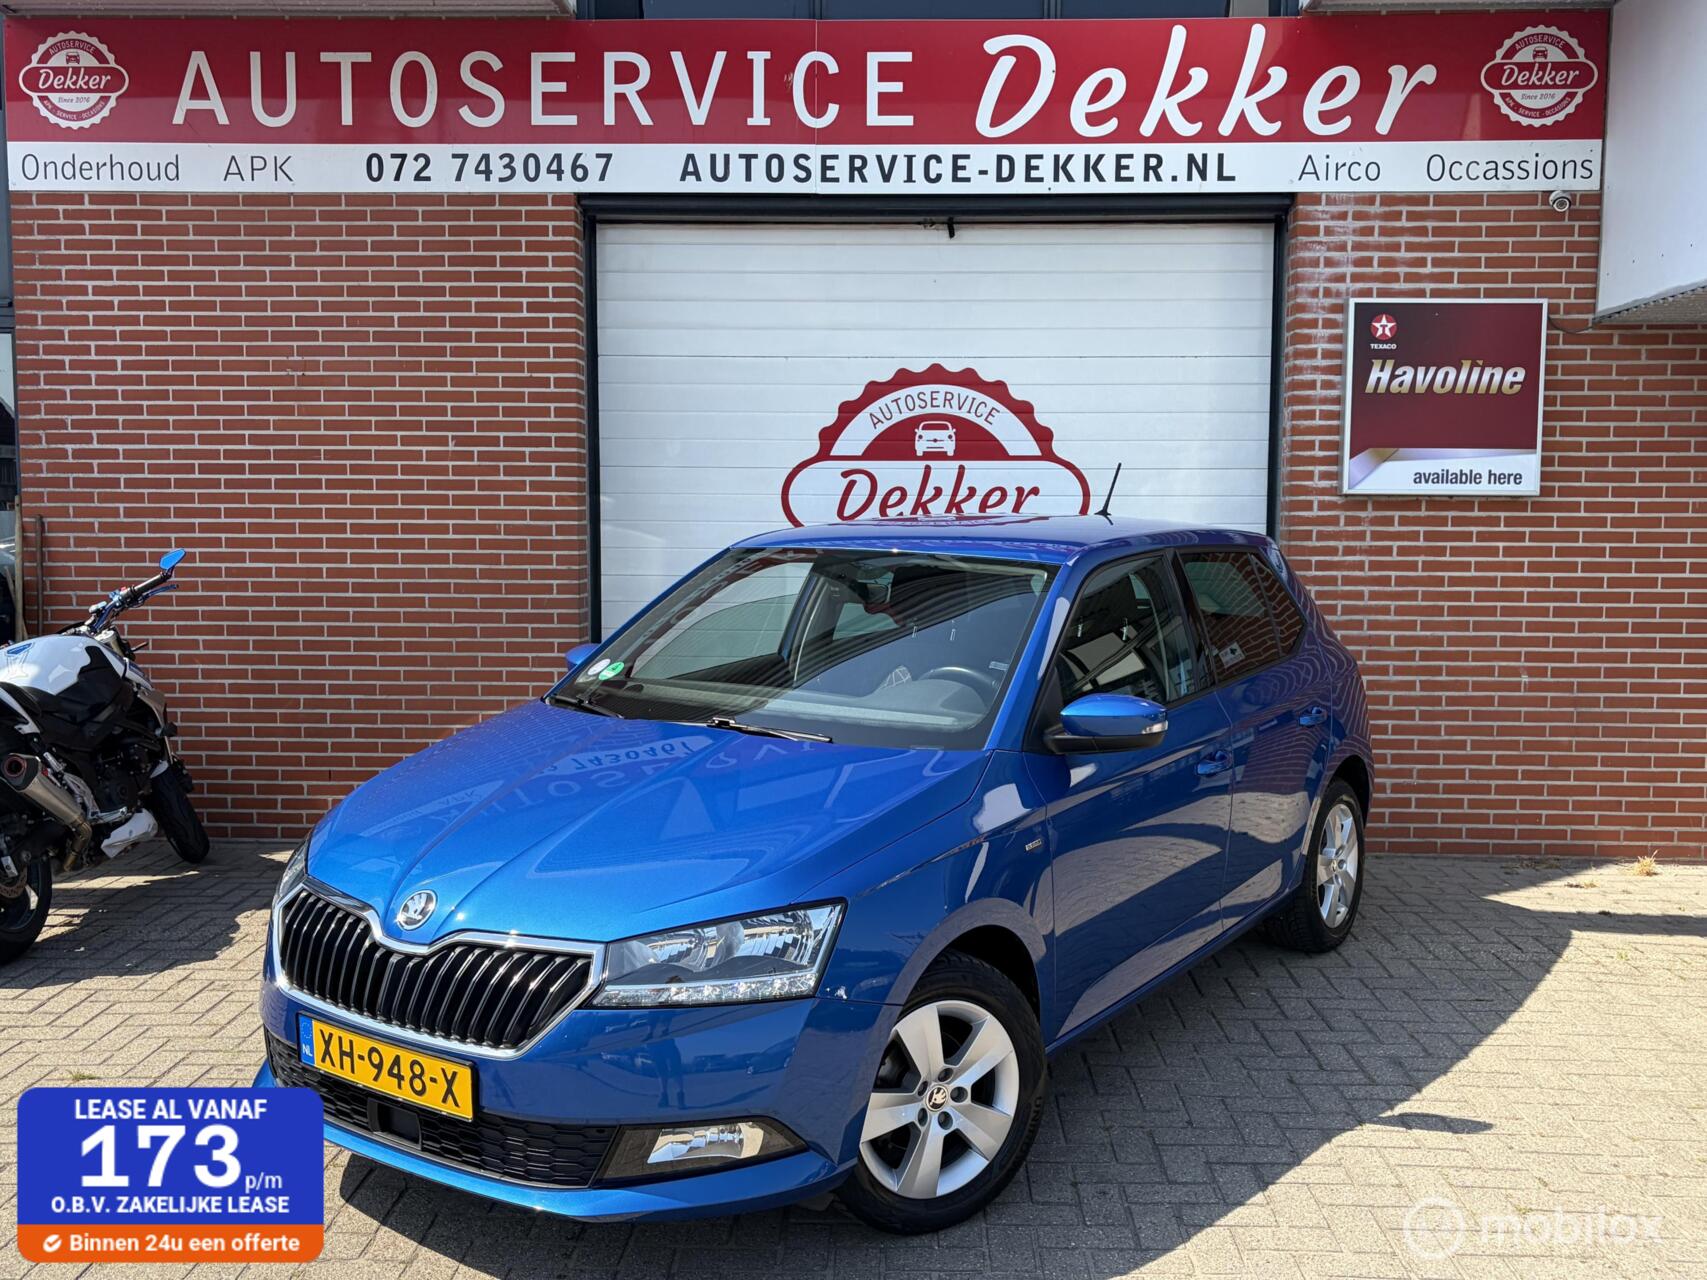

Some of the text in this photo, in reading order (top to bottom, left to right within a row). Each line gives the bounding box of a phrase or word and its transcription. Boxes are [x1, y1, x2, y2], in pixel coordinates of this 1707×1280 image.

[48, 40, 96, 56] AUTOSERVICE
[1514, 34, 1566, 51] AUTOSERVICE
[38, 67, 111, 90] Dekker
[171, 23, 1437, 139] AUTOSERVICE Dekker
[1501, 62, 1580, 86] Dekker
[1520, 93, 1538, 101] Since
[1518, 107, 1540, 118] SERVICE
[21, 152, 1594, 183] Onderhoud APK 072 7430467 AUTOSERVICE-DEKKER.NL Airco Occassions
[1364, 359, 1526, 395] Havoline
[869, 390, 1001, 430] AUTOSERVICE
[1413, 469, 1523, 485] available here
[836, 464, 1040, 522] Dekker
[302, 1029, 461, 1108] NL XH-948-X
